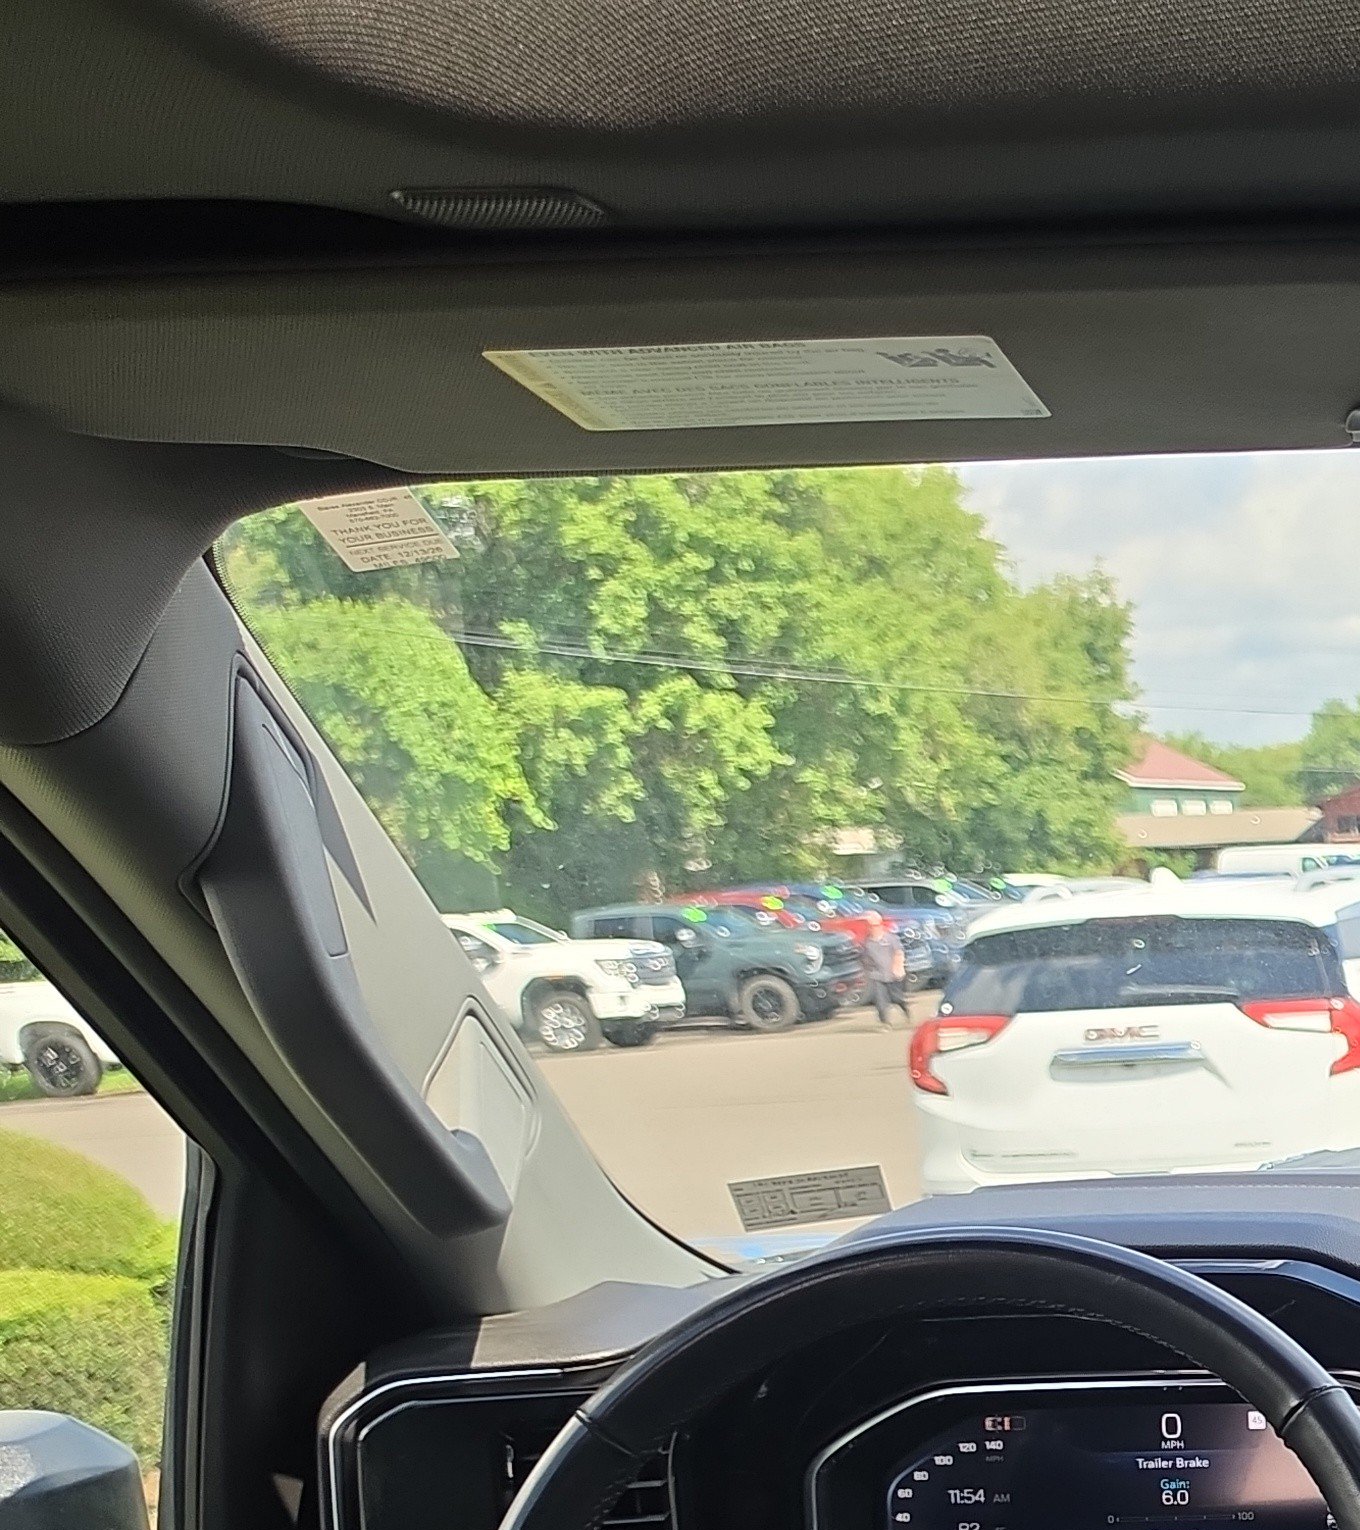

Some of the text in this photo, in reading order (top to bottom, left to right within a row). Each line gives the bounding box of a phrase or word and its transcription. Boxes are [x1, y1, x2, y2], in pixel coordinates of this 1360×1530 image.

[330, 517, 428, 536] THANK YOU FOR
[337, 525, 434, 544] YOUR BUSINESS
[376, 541, 420, 552] SERVICE
[1084, 1024, 1160, 1042] GMC
[1161, 1413, 1182, 1439] 0
[958, 1442, 977, 1452] 120
[984, 1440, 1003, 1450] 140
[1161, 1440, 1184, 1450] MPH
[934, 1455, 953, 1465] 100
[1135, 1457, 1210, 1470] Trailer Brake
[1160, 1478, 1190, 1489] Gain:
[947, 1488, 1011, 1504] 11:54 AM
[1161, 1490, 1189, 1505] 6.0
[1237, 1511, 1255, 1521] 100
